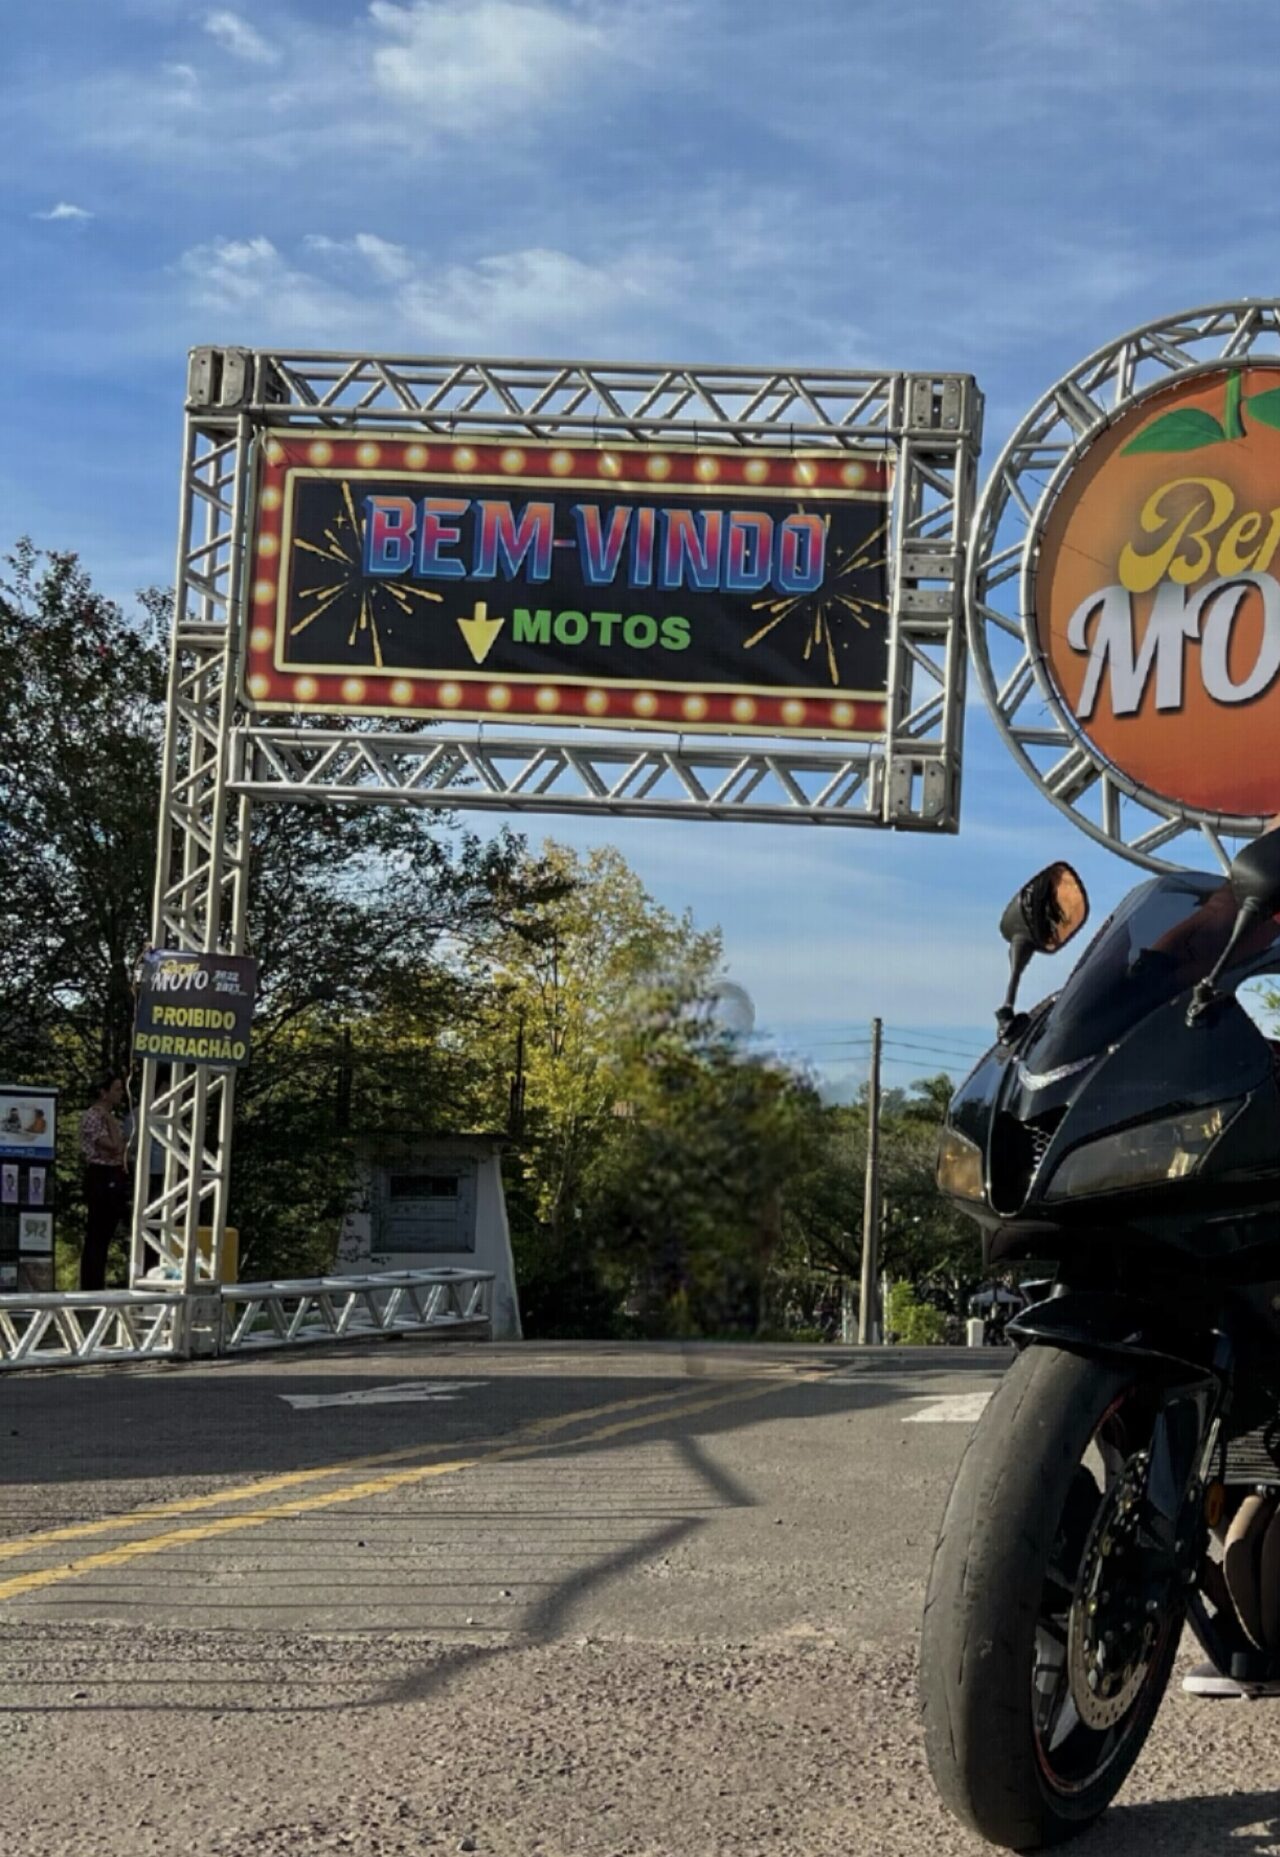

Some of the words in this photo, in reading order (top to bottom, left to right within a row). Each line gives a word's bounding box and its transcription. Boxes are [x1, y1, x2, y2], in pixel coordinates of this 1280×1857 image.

[361, 494, 831, 595] BEM-VINDO
[512, 608, 692, 651] MOTOS
[151, 1005, 236, 1031] PROIBIDO
[135, 1032, 246, 1061] BORRACHÃO
